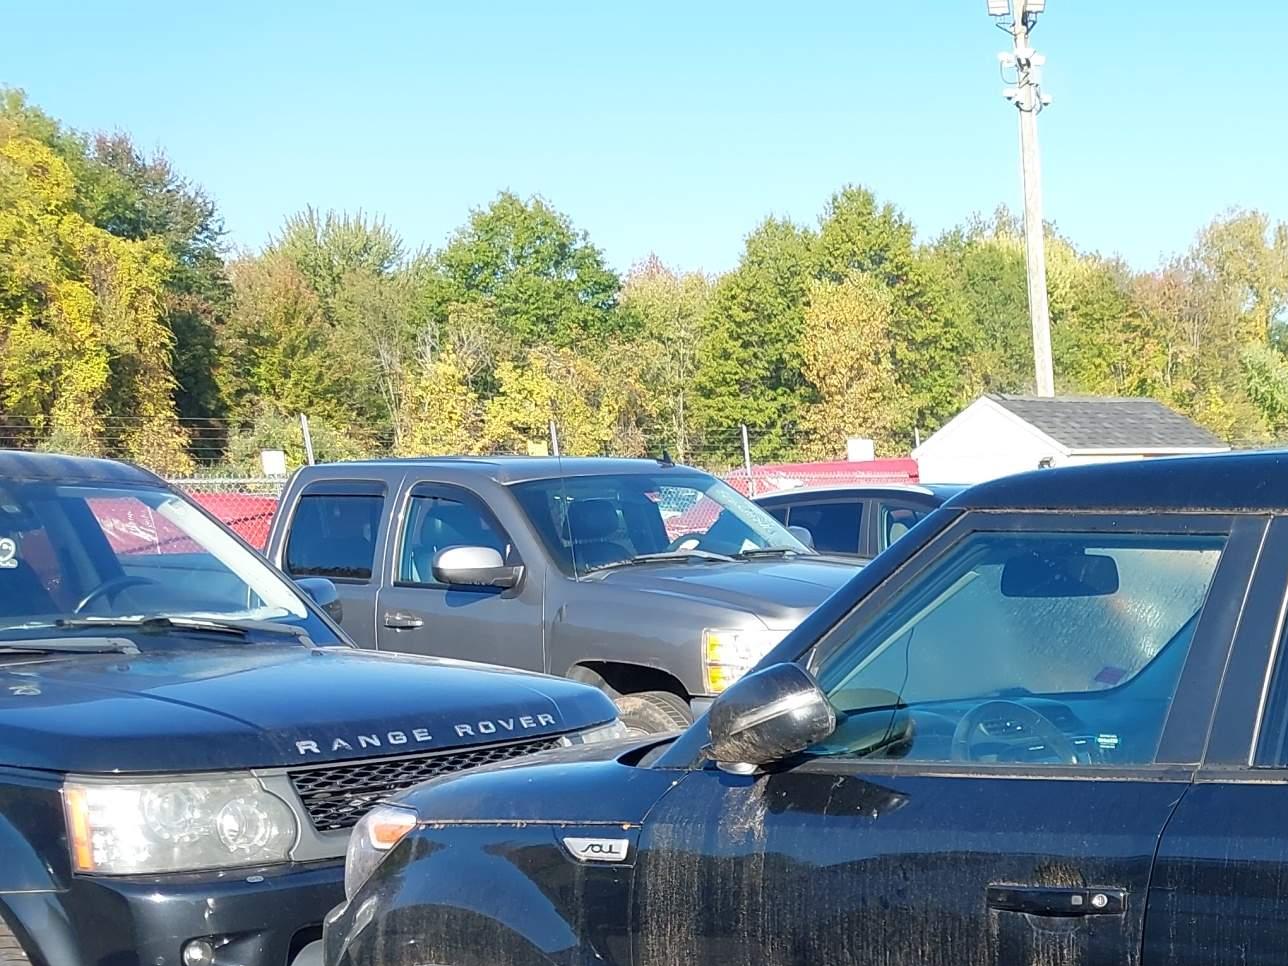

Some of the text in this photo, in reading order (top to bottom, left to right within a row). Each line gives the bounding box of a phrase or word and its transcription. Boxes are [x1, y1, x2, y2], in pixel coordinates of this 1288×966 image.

[295, 713, 556, 755] RANGE ROVER
[580, 843, 621, 854] SOUL
